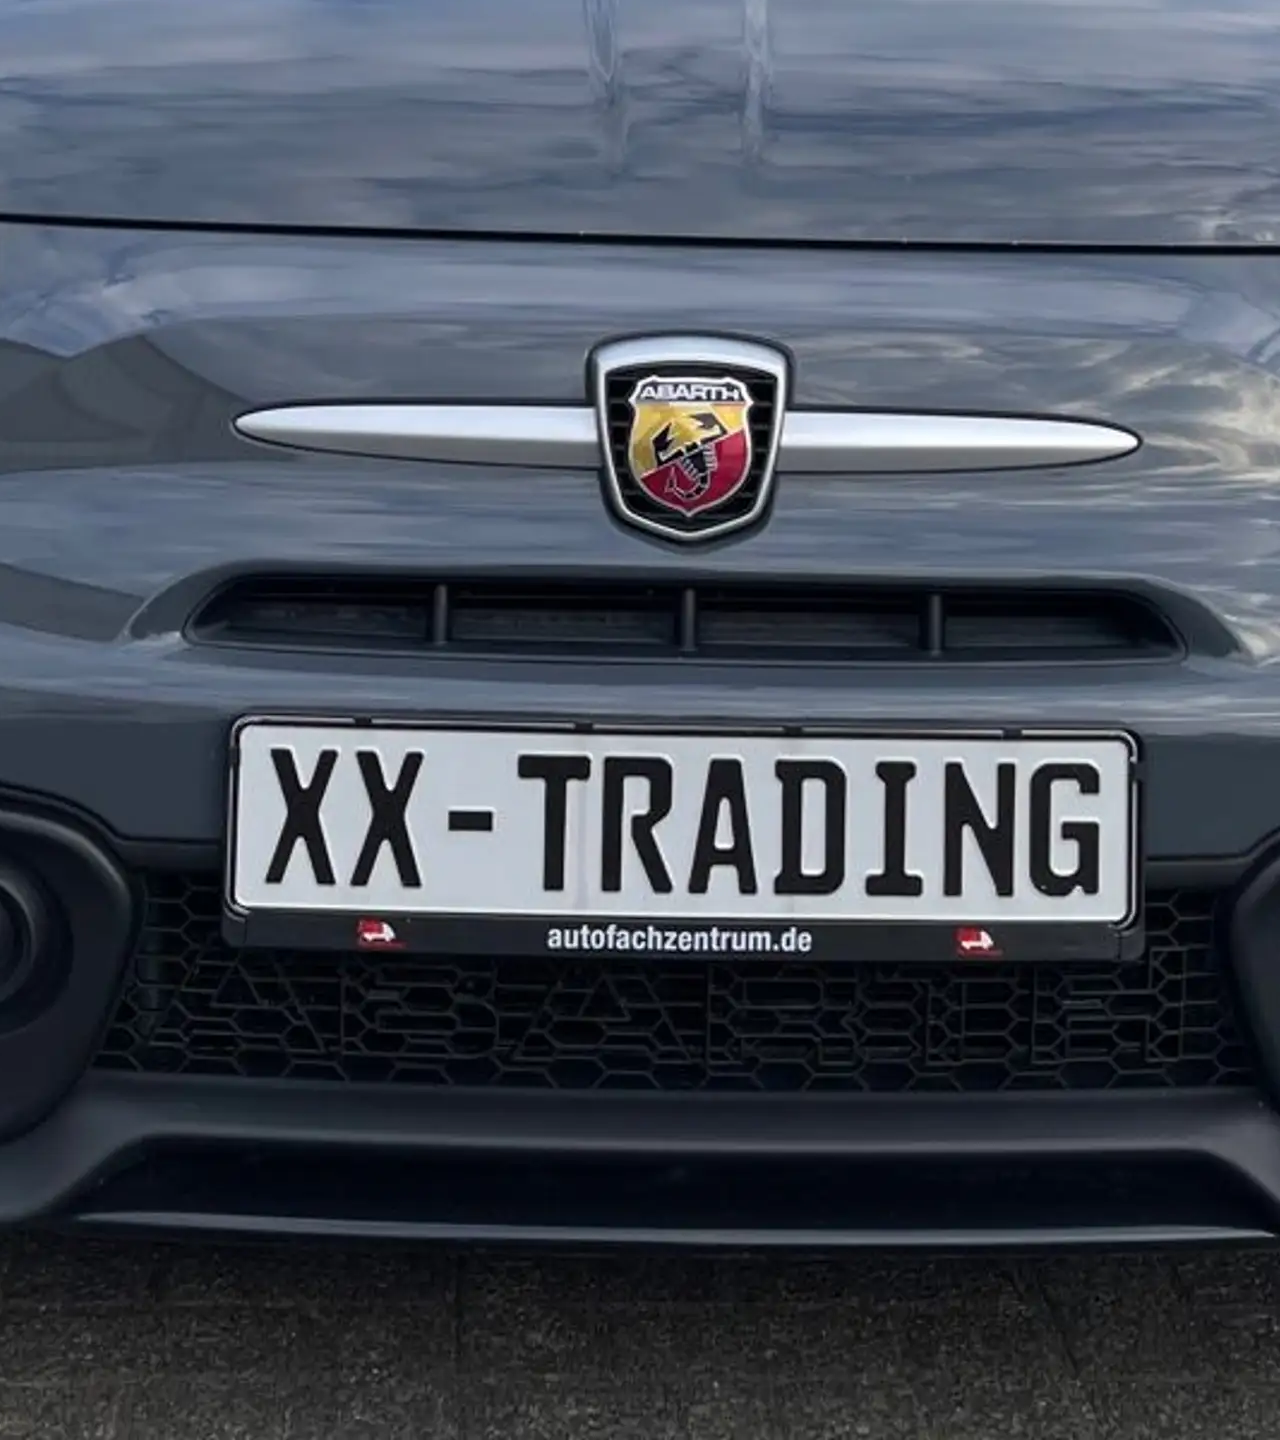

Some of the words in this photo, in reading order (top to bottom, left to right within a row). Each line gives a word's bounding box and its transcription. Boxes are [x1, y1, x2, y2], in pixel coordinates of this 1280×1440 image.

[640, 383, 740, 400] ABARTH
[264, 746, 1100, 897] XX-TRADING
[547, 923, 813, 953] autofachzentrum.de
